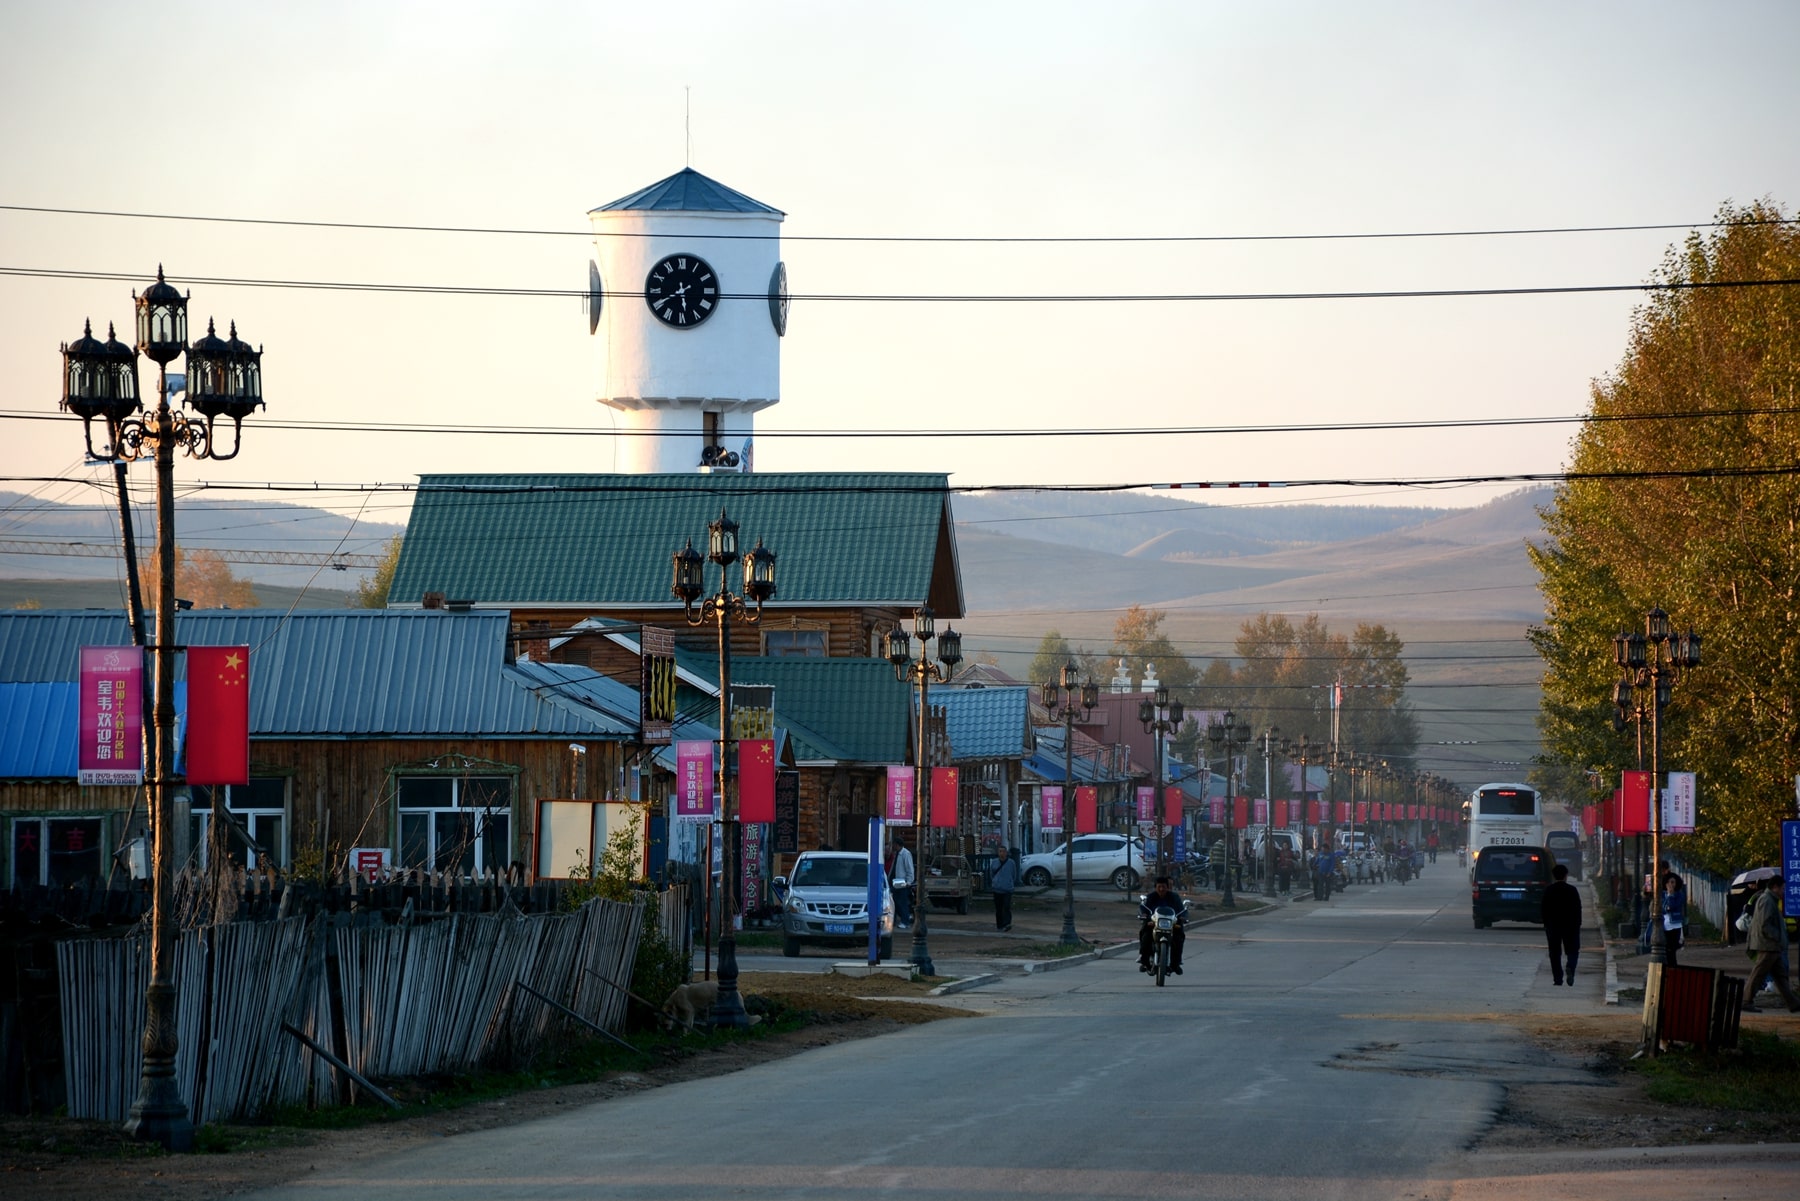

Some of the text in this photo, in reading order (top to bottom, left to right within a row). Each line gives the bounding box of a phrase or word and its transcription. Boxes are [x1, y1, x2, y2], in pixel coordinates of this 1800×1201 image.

[97, 680, 112, 760] 室韦欢迎您
[115, 680, 125, 760] 中国十大魅力名镇
[777, 776, 795, 849] 旅游纪念品
